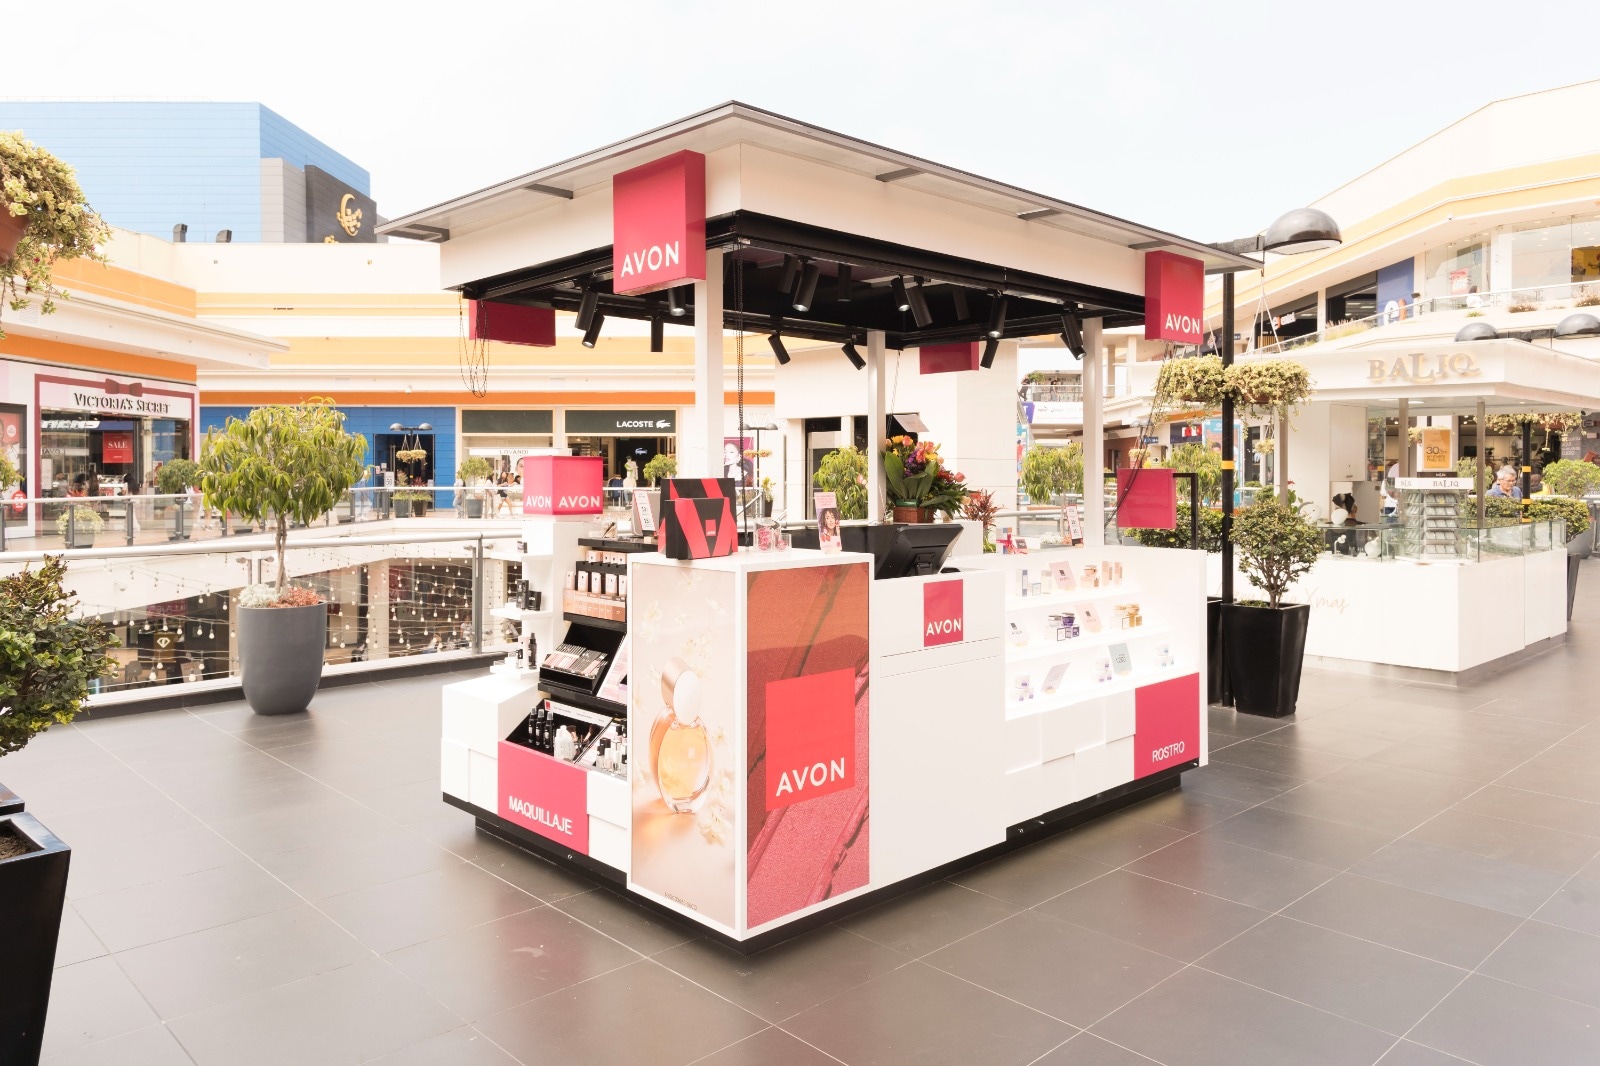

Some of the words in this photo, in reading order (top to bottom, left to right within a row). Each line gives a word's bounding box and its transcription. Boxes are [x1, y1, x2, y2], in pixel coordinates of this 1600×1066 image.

[620, 240, 680, 278] AVON
[1164, 312, 1201, 335] AVON
[1367, 352, 1480, 381] BALIQ
[73, 392, 134, 412] VICTORIA'S
[136, 398, 171, 414] SECRET
[616, 419, 654, 429] LACOSTE
[107, 440, 128, 449] SALE
[1426, 446, 1440, 455] 30
[1433, 479, 1460, 488] BALIQ
[525, 496, 552, 509] AVON
[558, 495, 601, 509] AVON
[925, 617, 963, 637] AVON
[1152, 740, 1185, 763] ROSTRO
[775, 756, 846, 797] AVON
[508, 795, 573, 836] MAQUILLAJE
